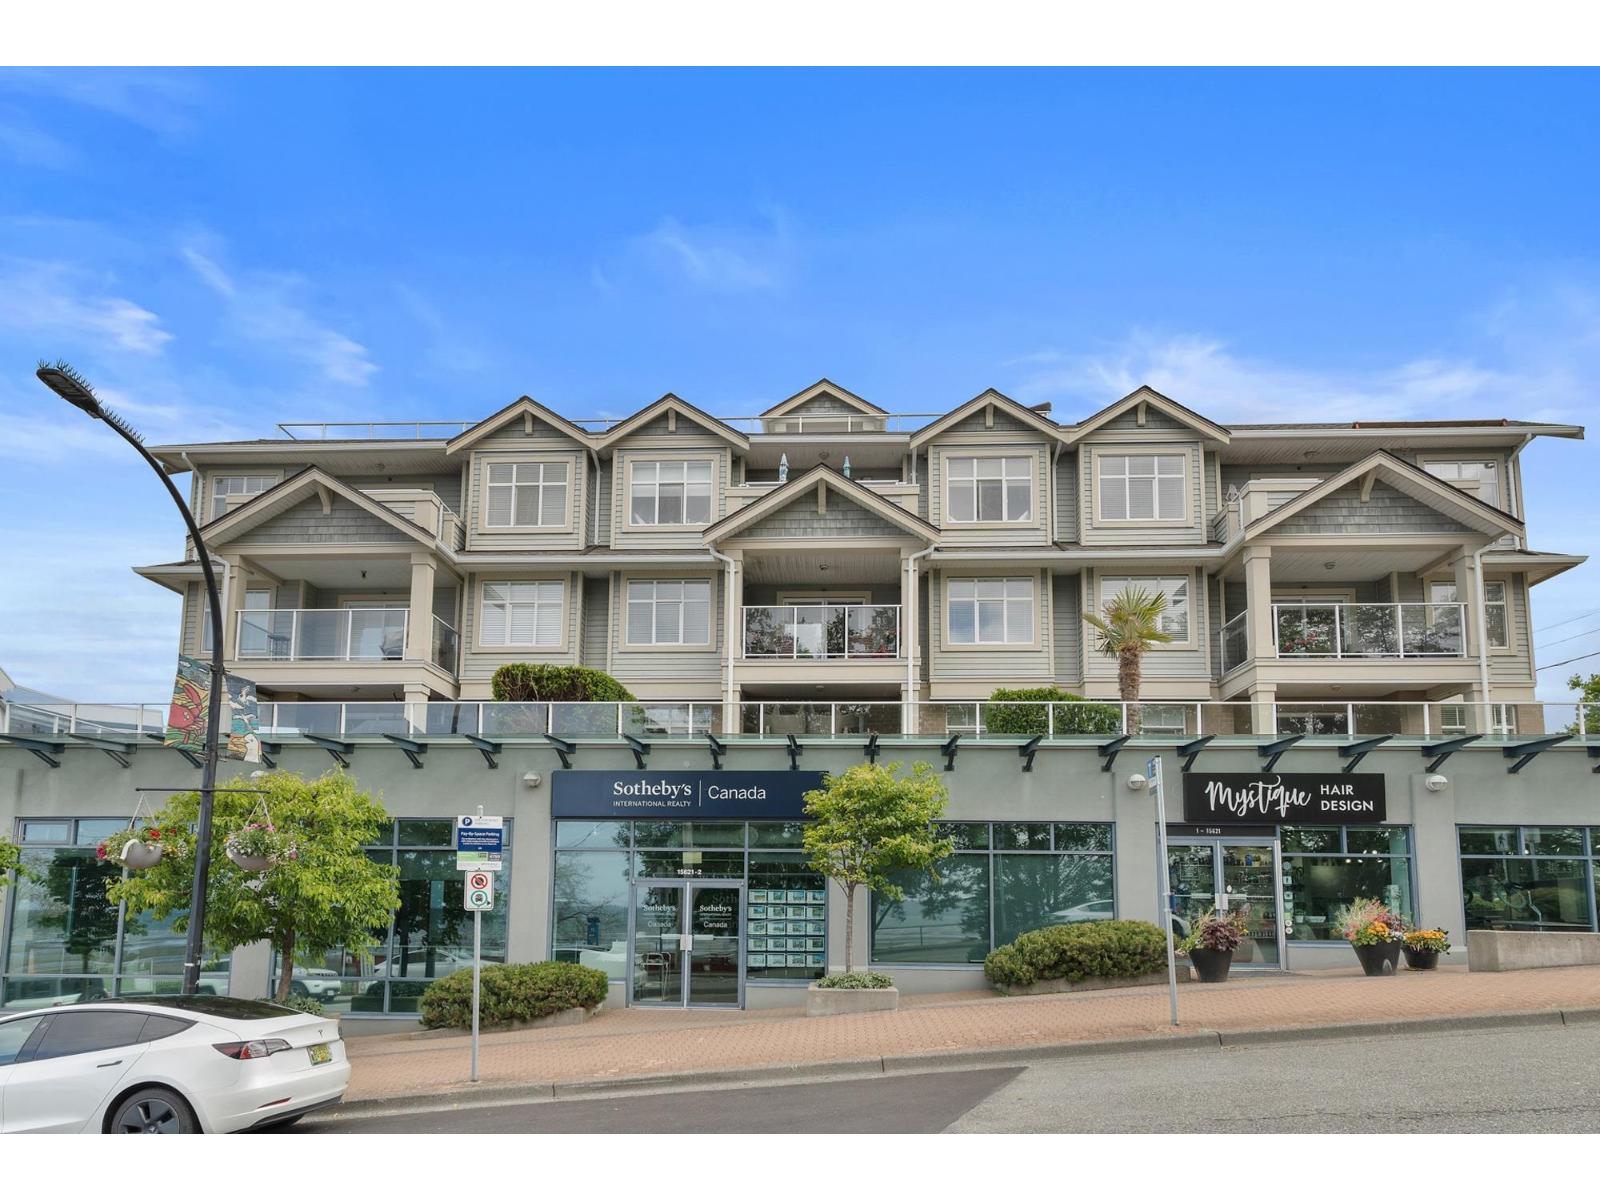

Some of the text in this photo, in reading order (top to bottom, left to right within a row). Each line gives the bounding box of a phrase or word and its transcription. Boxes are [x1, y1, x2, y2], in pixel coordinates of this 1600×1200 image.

[613, 779, 766, 800] Sotheby's Canada
[1320, 784, 1354, 796] HAIR
[1204, 775, 1312, 818] Mystique
[613, 800, 666, 808] INTERNATIONAL
[1320, 800, 1374, 811] DESIGN
[699, 904, 732, 913] Sotheby's
[647, 920, 672, 928] Canada
[703, 920, 728, 928] Canada
